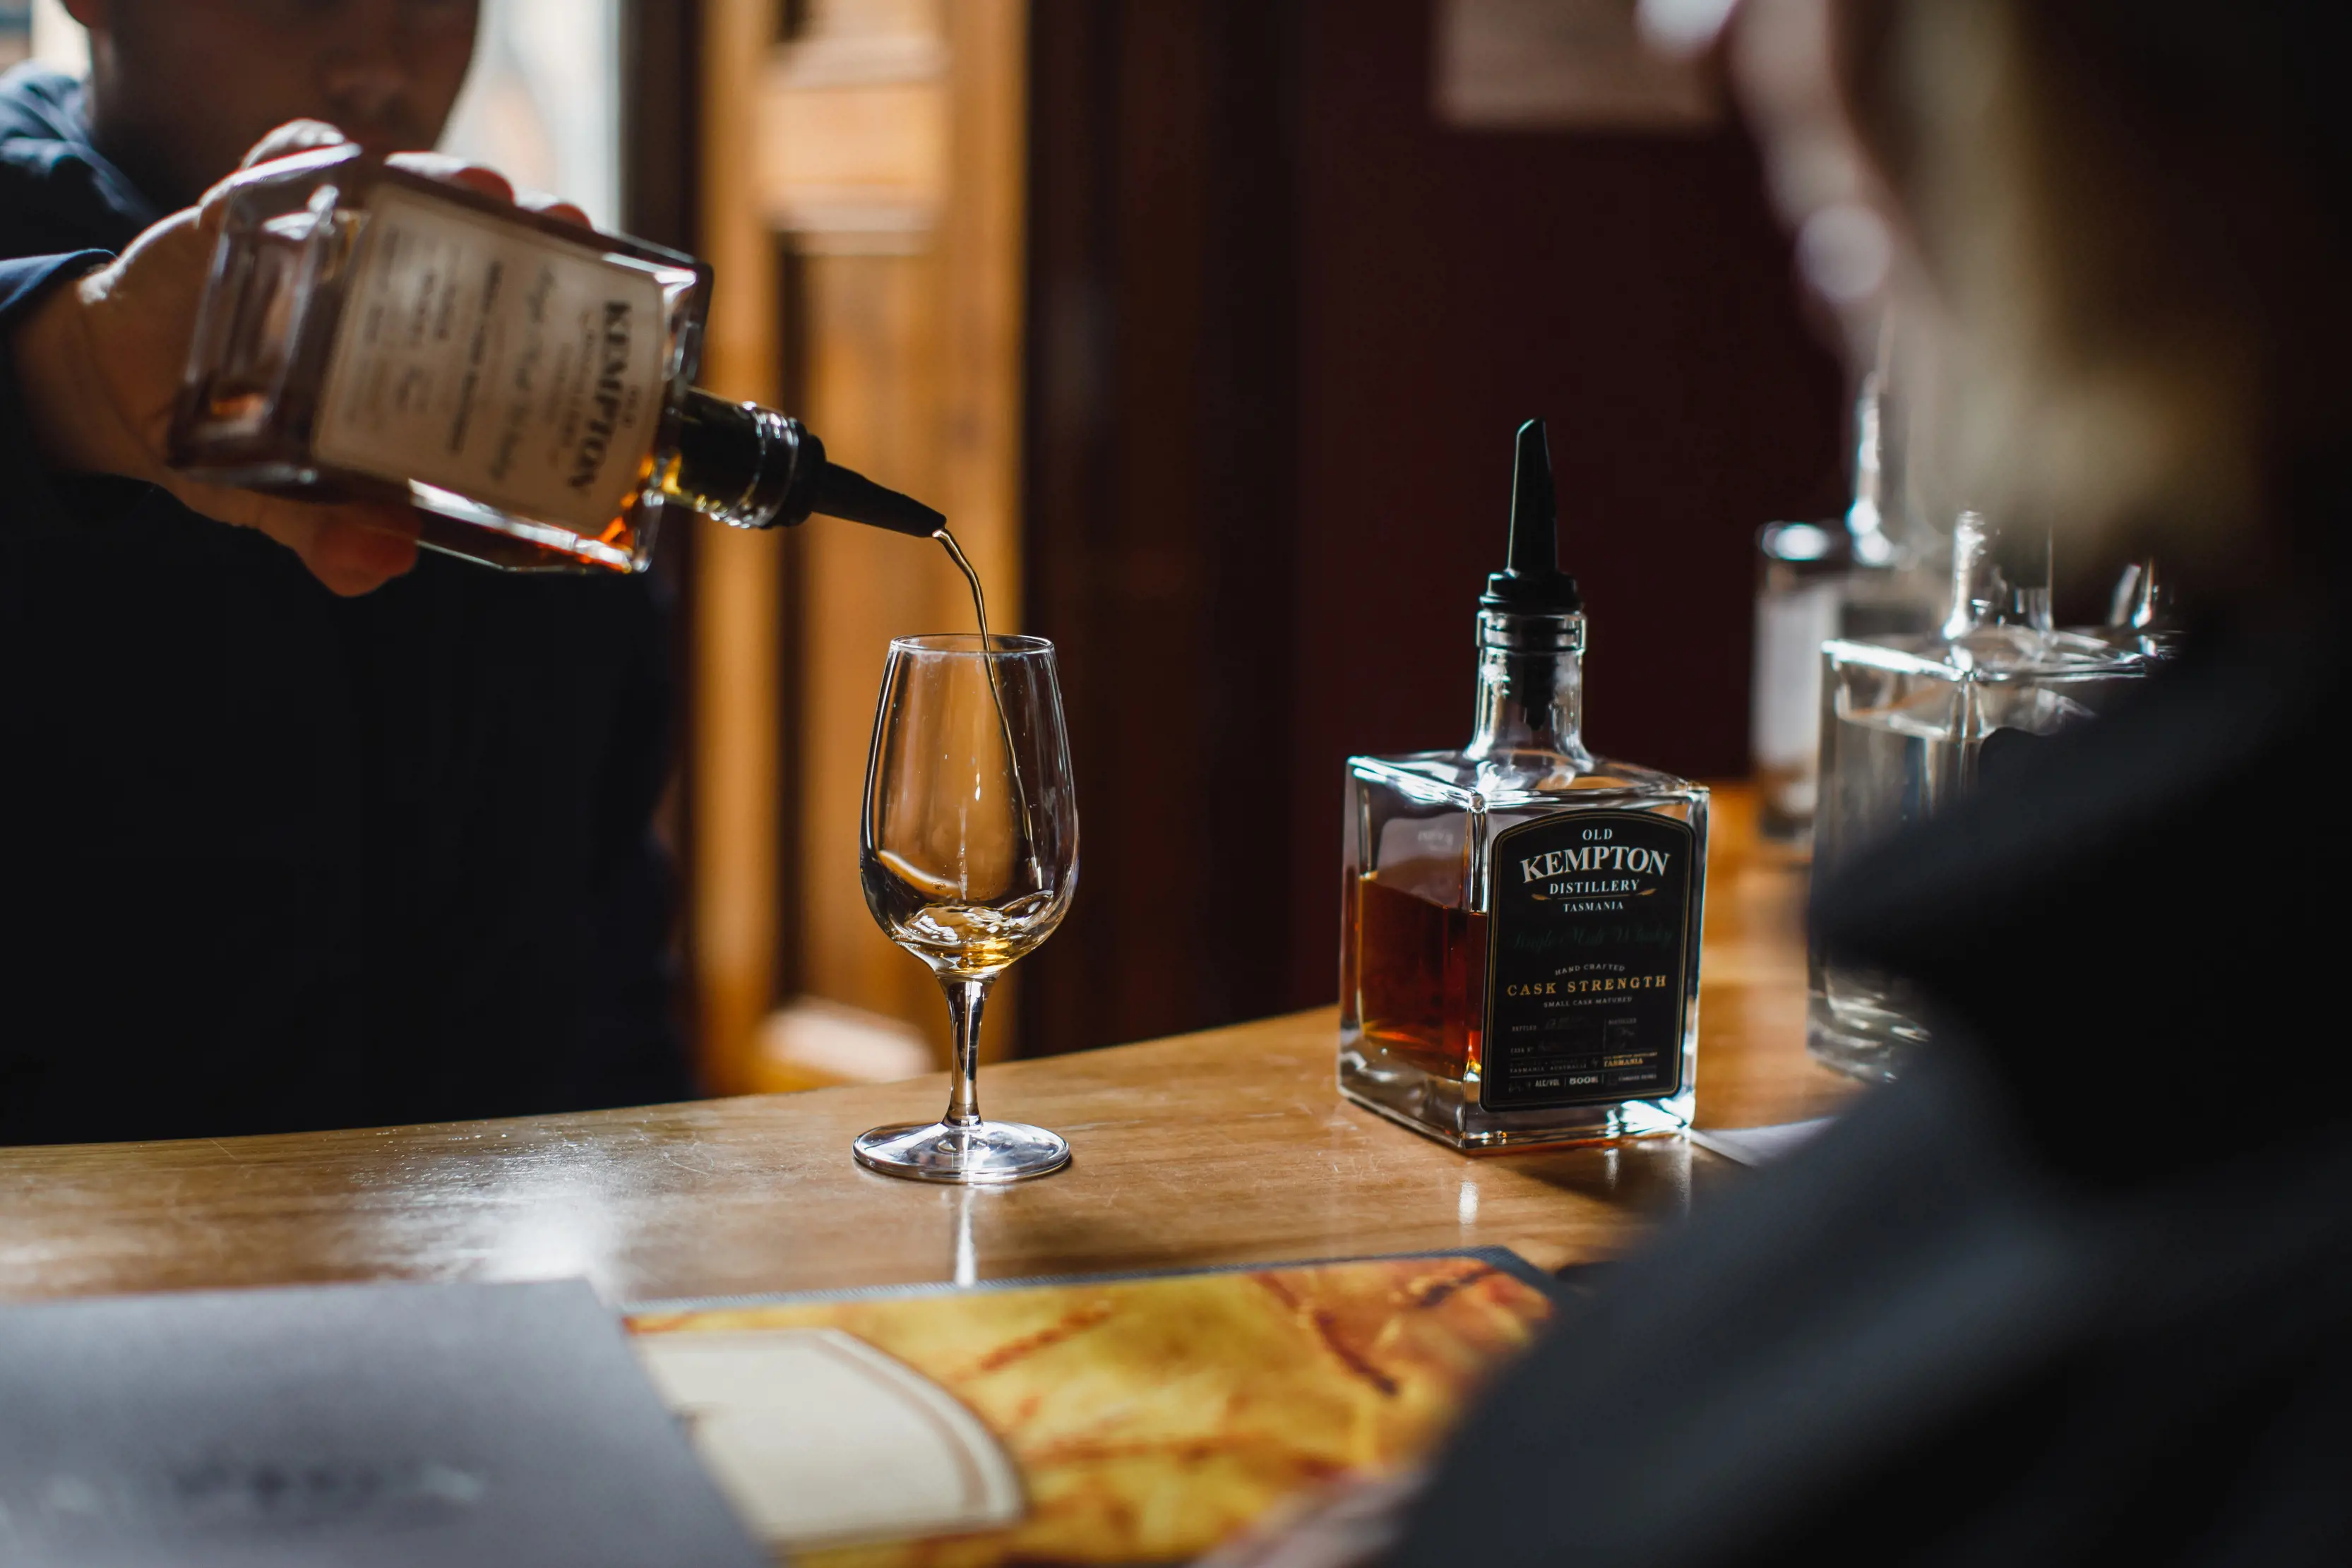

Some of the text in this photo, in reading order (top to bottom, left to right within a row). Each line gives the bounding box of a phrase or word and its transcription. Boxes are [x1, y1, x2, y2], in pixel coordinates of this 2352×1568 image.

[568, 300, 633, 489] KEMPTON
[1582, 827, 1613, 841] OLD
[1520, 846, 1671, 884] KEMPTON
[1548, 878, 1640, 895] DISTILLERY
[1563, 900, 1624, 913] TASMANIA
[1555, 963, 1625, 976] HAND CRAFTED
[1507, 974, 1667, 997] CASK STRENGTH
[1595, 996, 1633, 1005] MATURED
[1535, 1078, 1560, 1087] ALC/VOL
